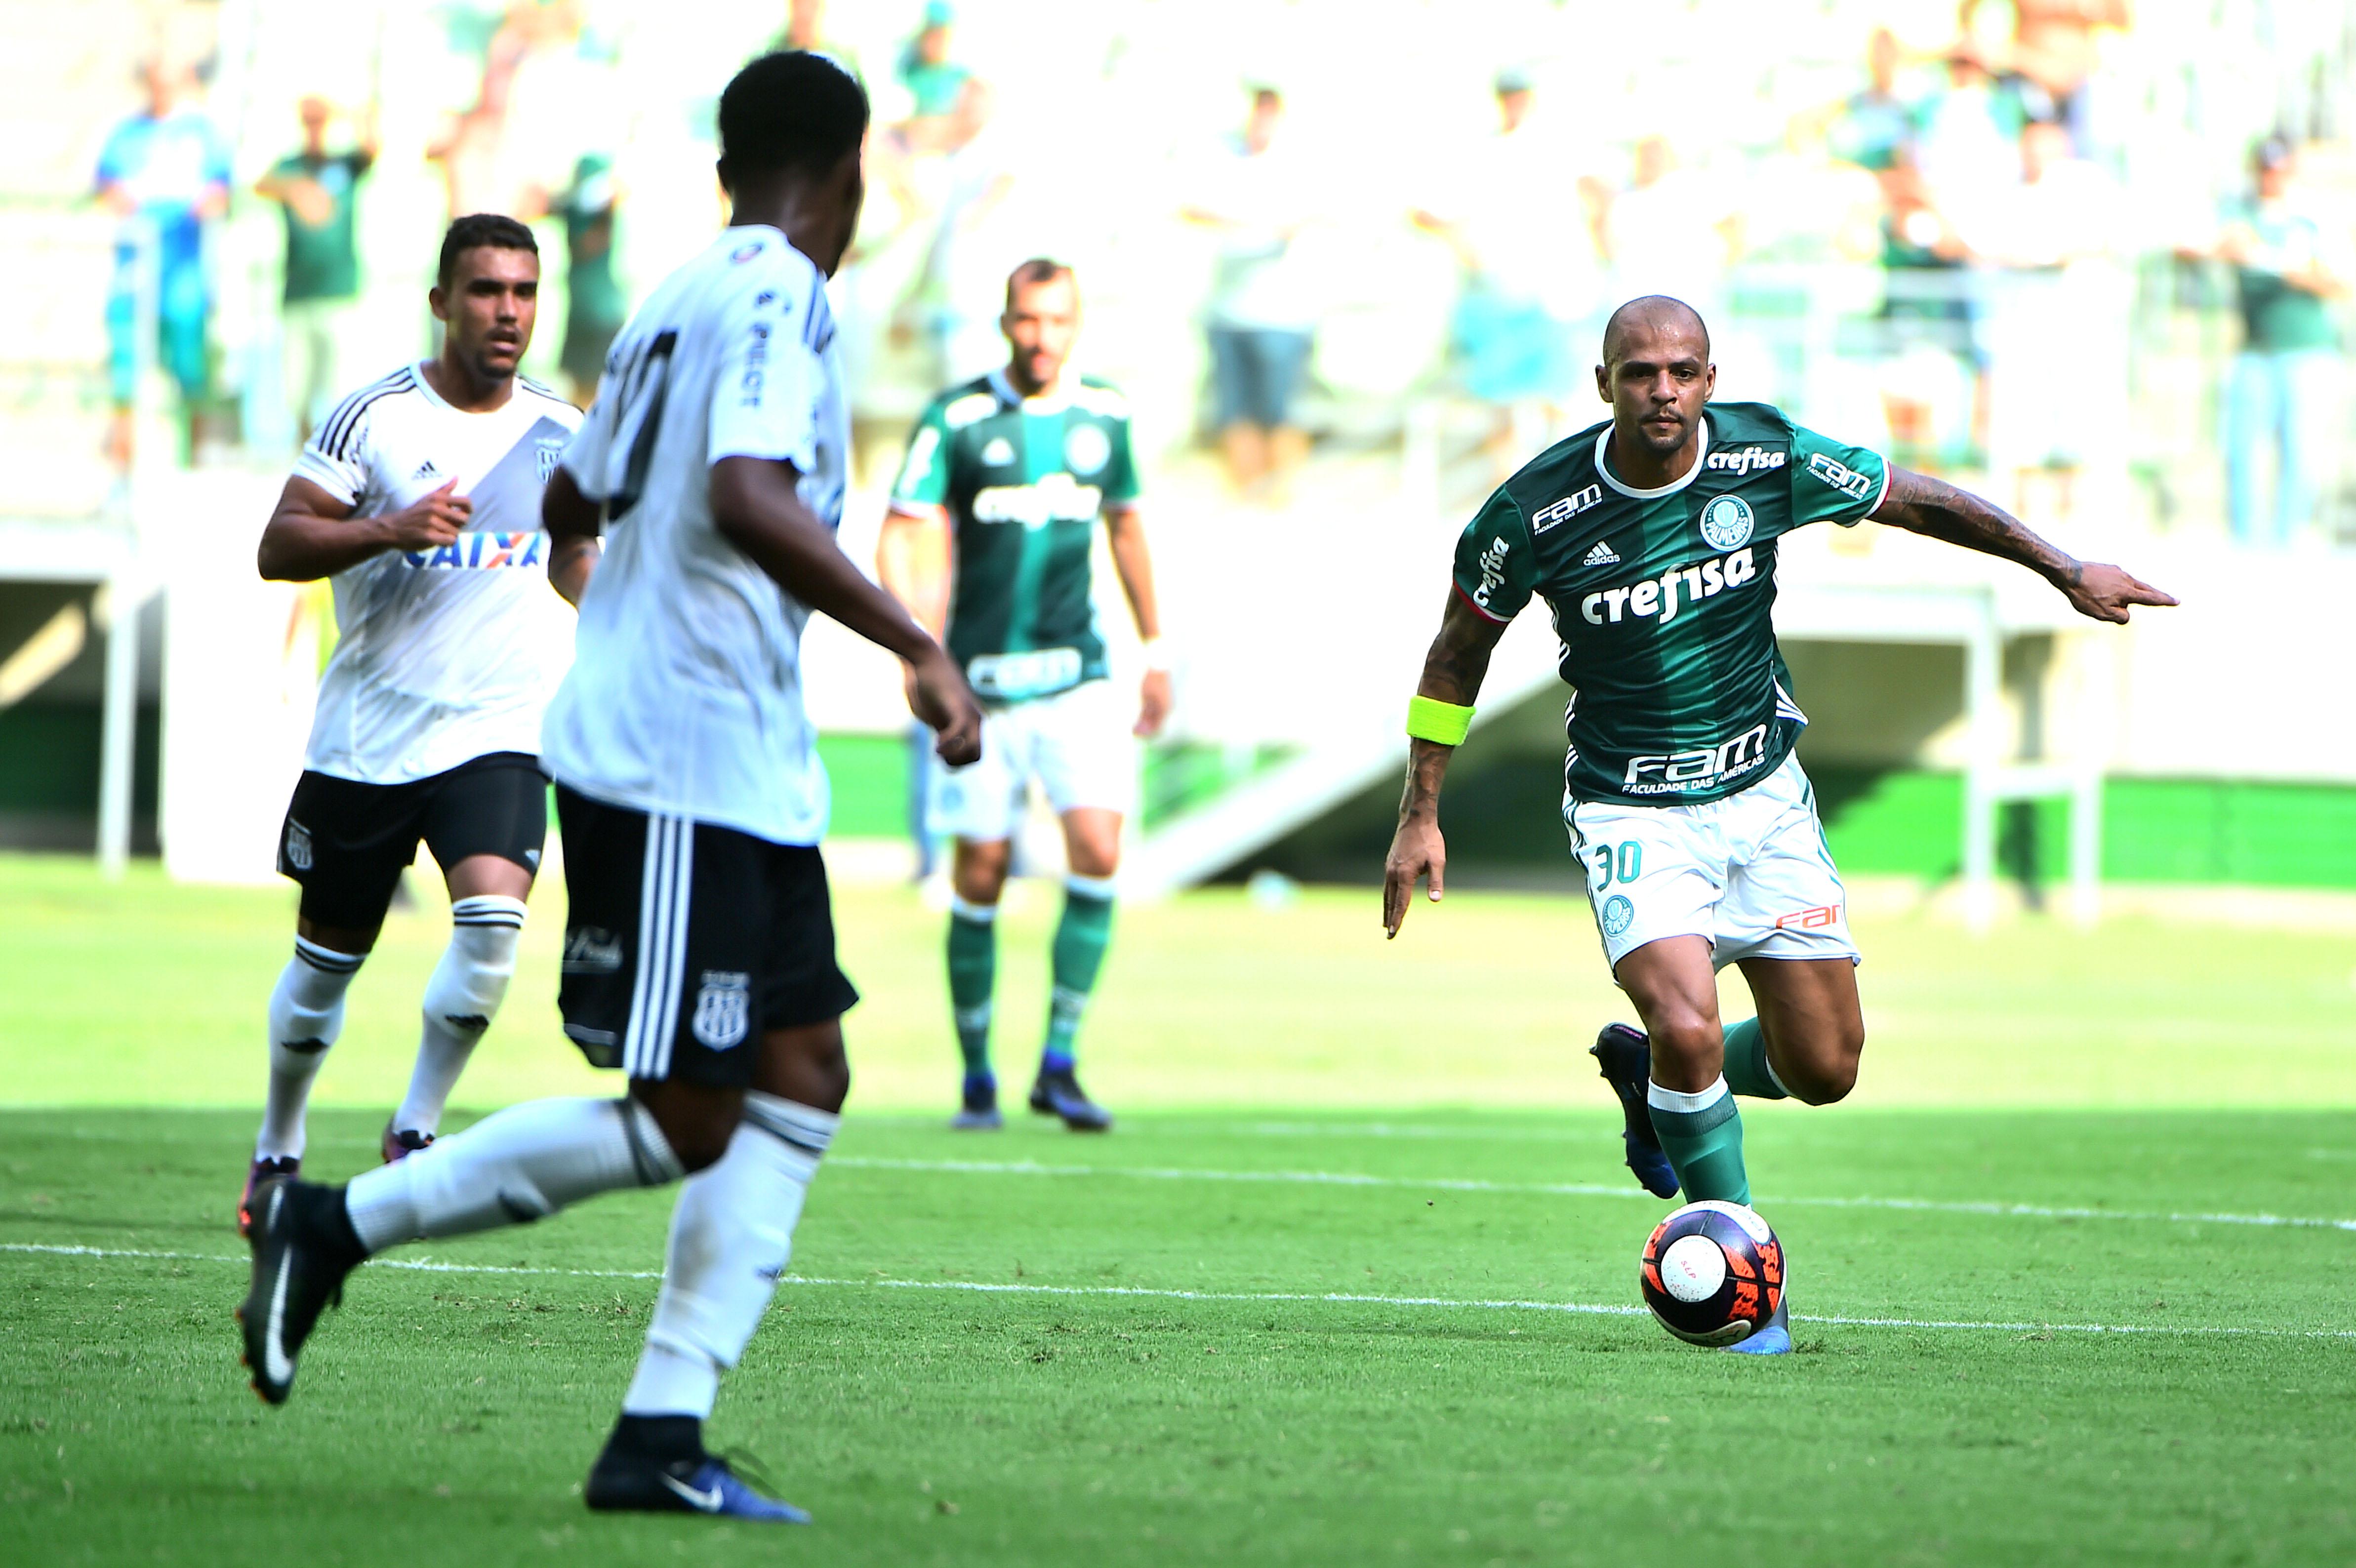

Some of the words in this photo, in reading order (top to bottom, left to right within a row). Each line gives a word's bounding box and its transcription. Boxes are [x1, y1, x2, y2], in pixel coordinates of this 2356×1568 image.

[1707, 446, 1785, 476] crefisa
[1535, 517, 1564, 536] FACULDADE
[1564, 511, 1576, 520] DAS
[1706, 517, 1749, 546] PALMEIRAS
[1473, 536, 1509, 607] crefisa
[1584, 554, 1621, 566] adidas
[1582, 547, 1755, 625] crefisa
[1622, 781, 1687, 794] FACULDADE
[1691, 777, 1714, 790] DAS
[1717, 754, 1765, 783] AMÉRICAS
[1595, 841, 1642, 893] 30
